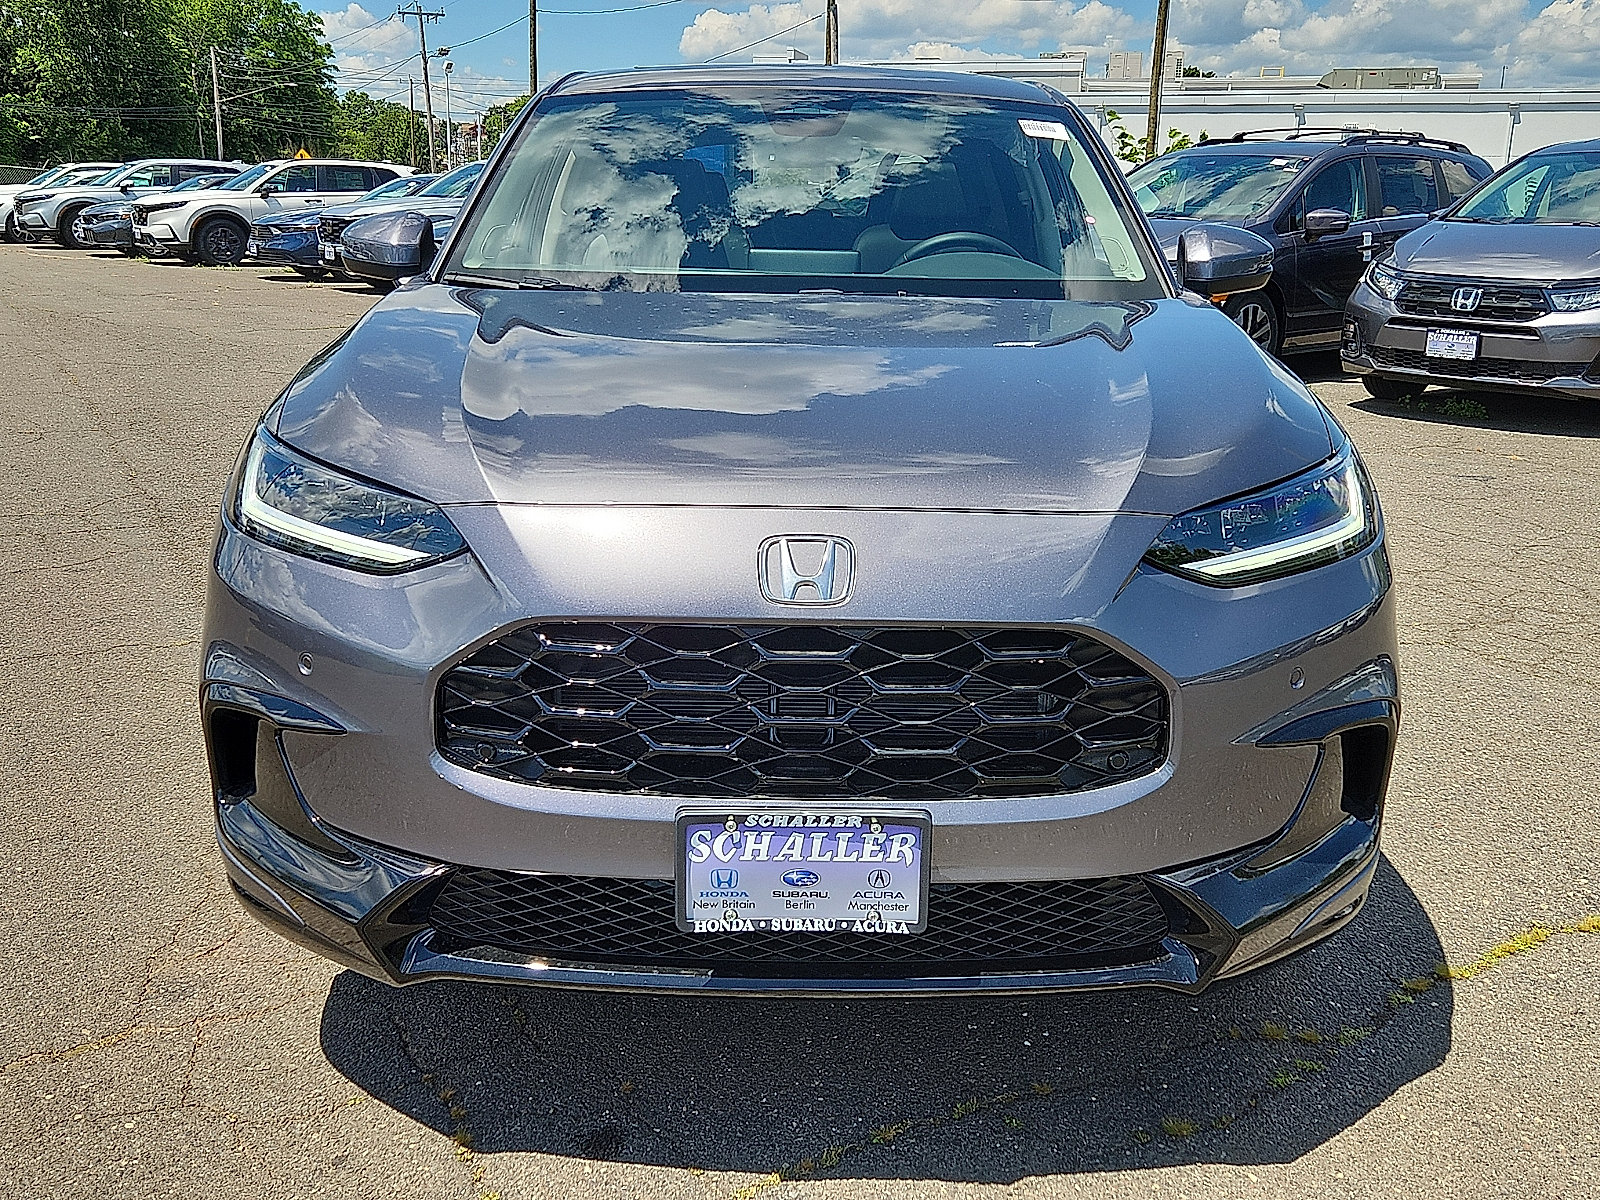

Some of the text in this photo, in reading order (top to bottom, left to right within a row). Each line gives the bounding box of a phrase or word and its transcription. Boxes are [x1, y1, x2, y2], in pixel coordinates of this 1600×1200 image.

[744, 814, 863, 829] SCHALLER
[688, 829, 917, 868] SCHALLER
[852, 891, 905, 900] ACURA
[692, 899, 756, 910] New Britain
[785, 899, 815, 910] Berlin
[847, 900, 910, 912] Manchester
[693, 918, 910, 934] HONDA SUBARU ACURA
